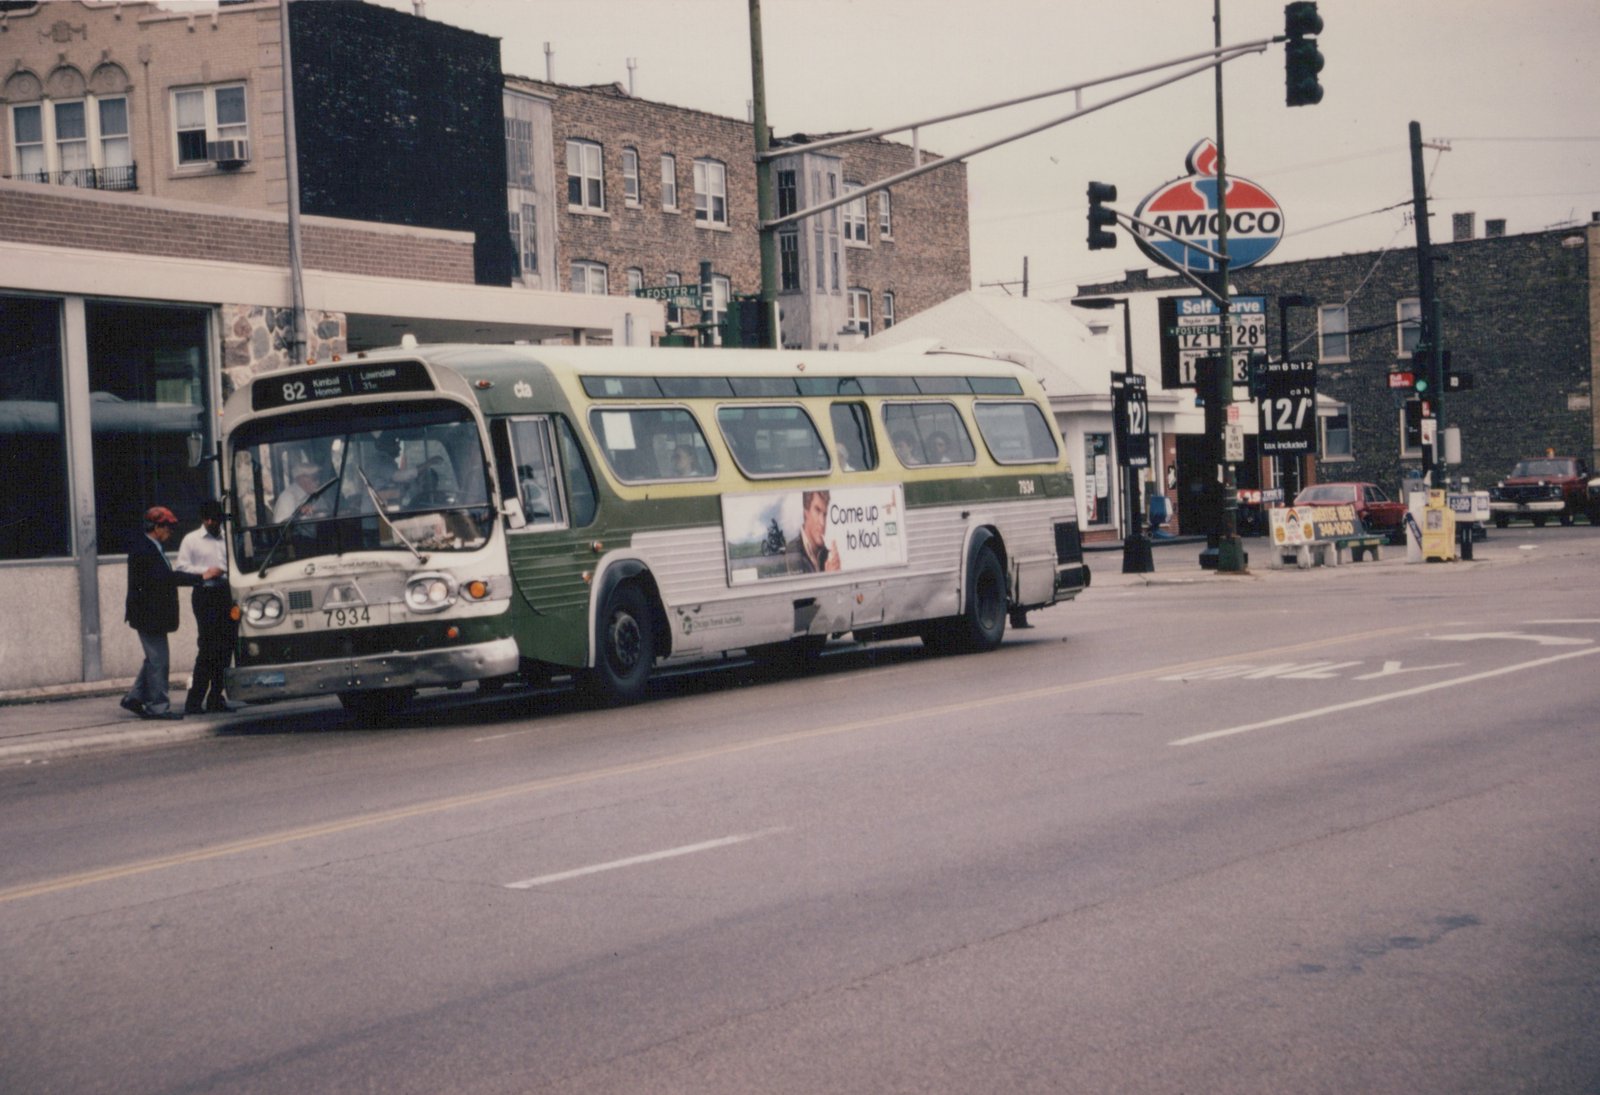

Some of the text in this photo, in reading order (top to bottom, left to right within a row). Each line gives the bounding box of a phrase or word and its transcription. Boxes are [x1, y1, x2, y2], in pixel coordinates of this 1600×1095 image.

[1148, 211, 1280, 236] AMOCO
[647, 287, 688, 299] FOSTER
[1182, 300, 1260, 314] Self erve
[1175, 327, 1209, 336] FOSTER
[360, 368, 396, 380] Lawndale
[312, 376, 340, 387] Kimball
[282, 382, 307, 401] 82
[315, 386, 342, 397] Homan
[513, 380, 533, 398] cta
[1277, 440, 1307, 449] included
[830, 504, 879, 525] Come up
[846, 531, 857, 550] to
[323, 607, 371, 627] 7934
